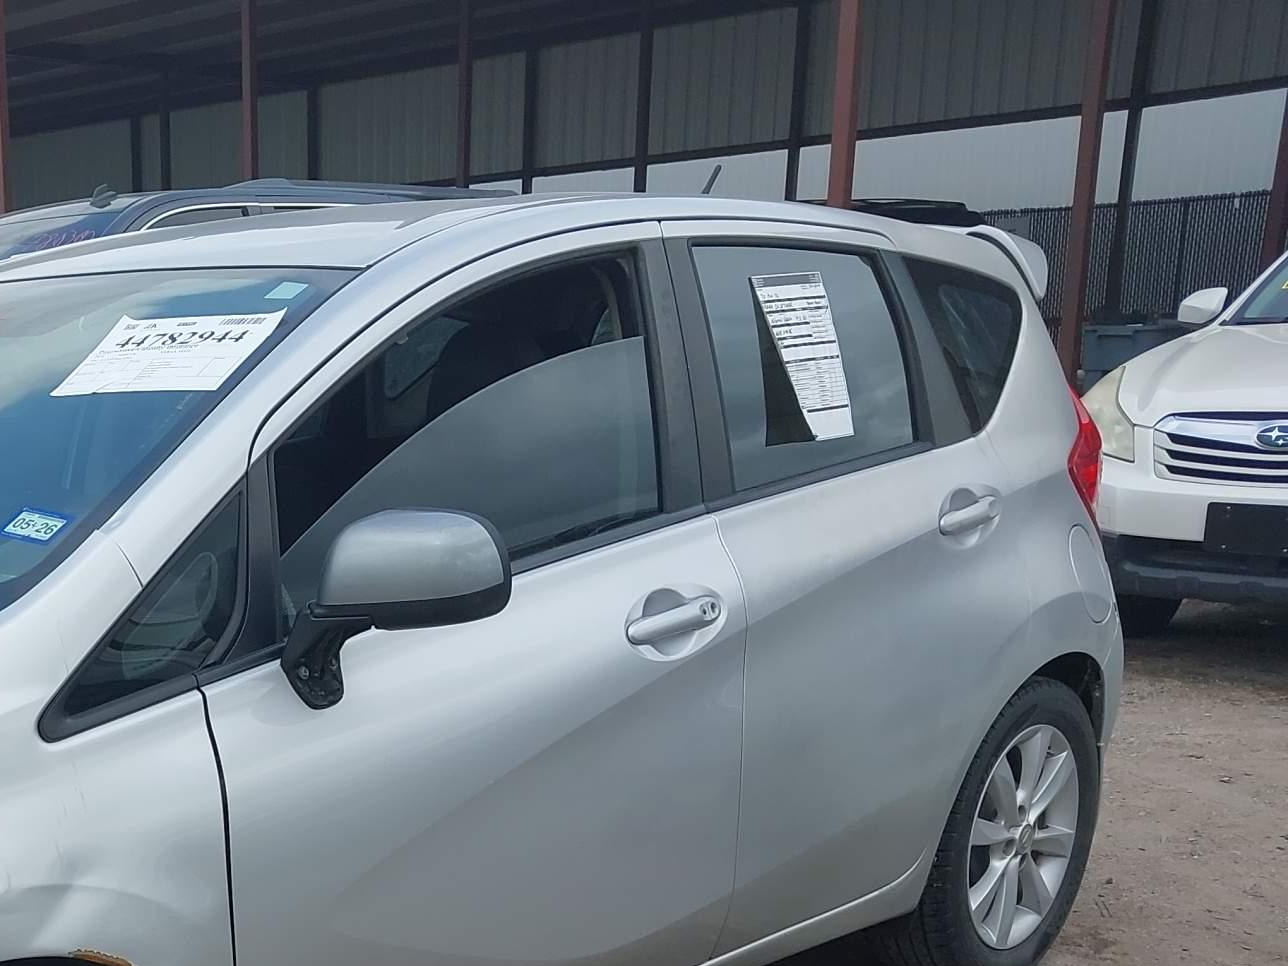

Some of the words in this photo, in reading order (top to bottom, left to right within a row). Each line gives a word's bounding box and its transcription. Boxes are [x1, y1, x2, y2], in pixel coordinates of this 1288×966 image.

[115, 329, 250, 348] 44782944
[12, 517, 36, 530] 05
[35, 522, 58, 535] 26
